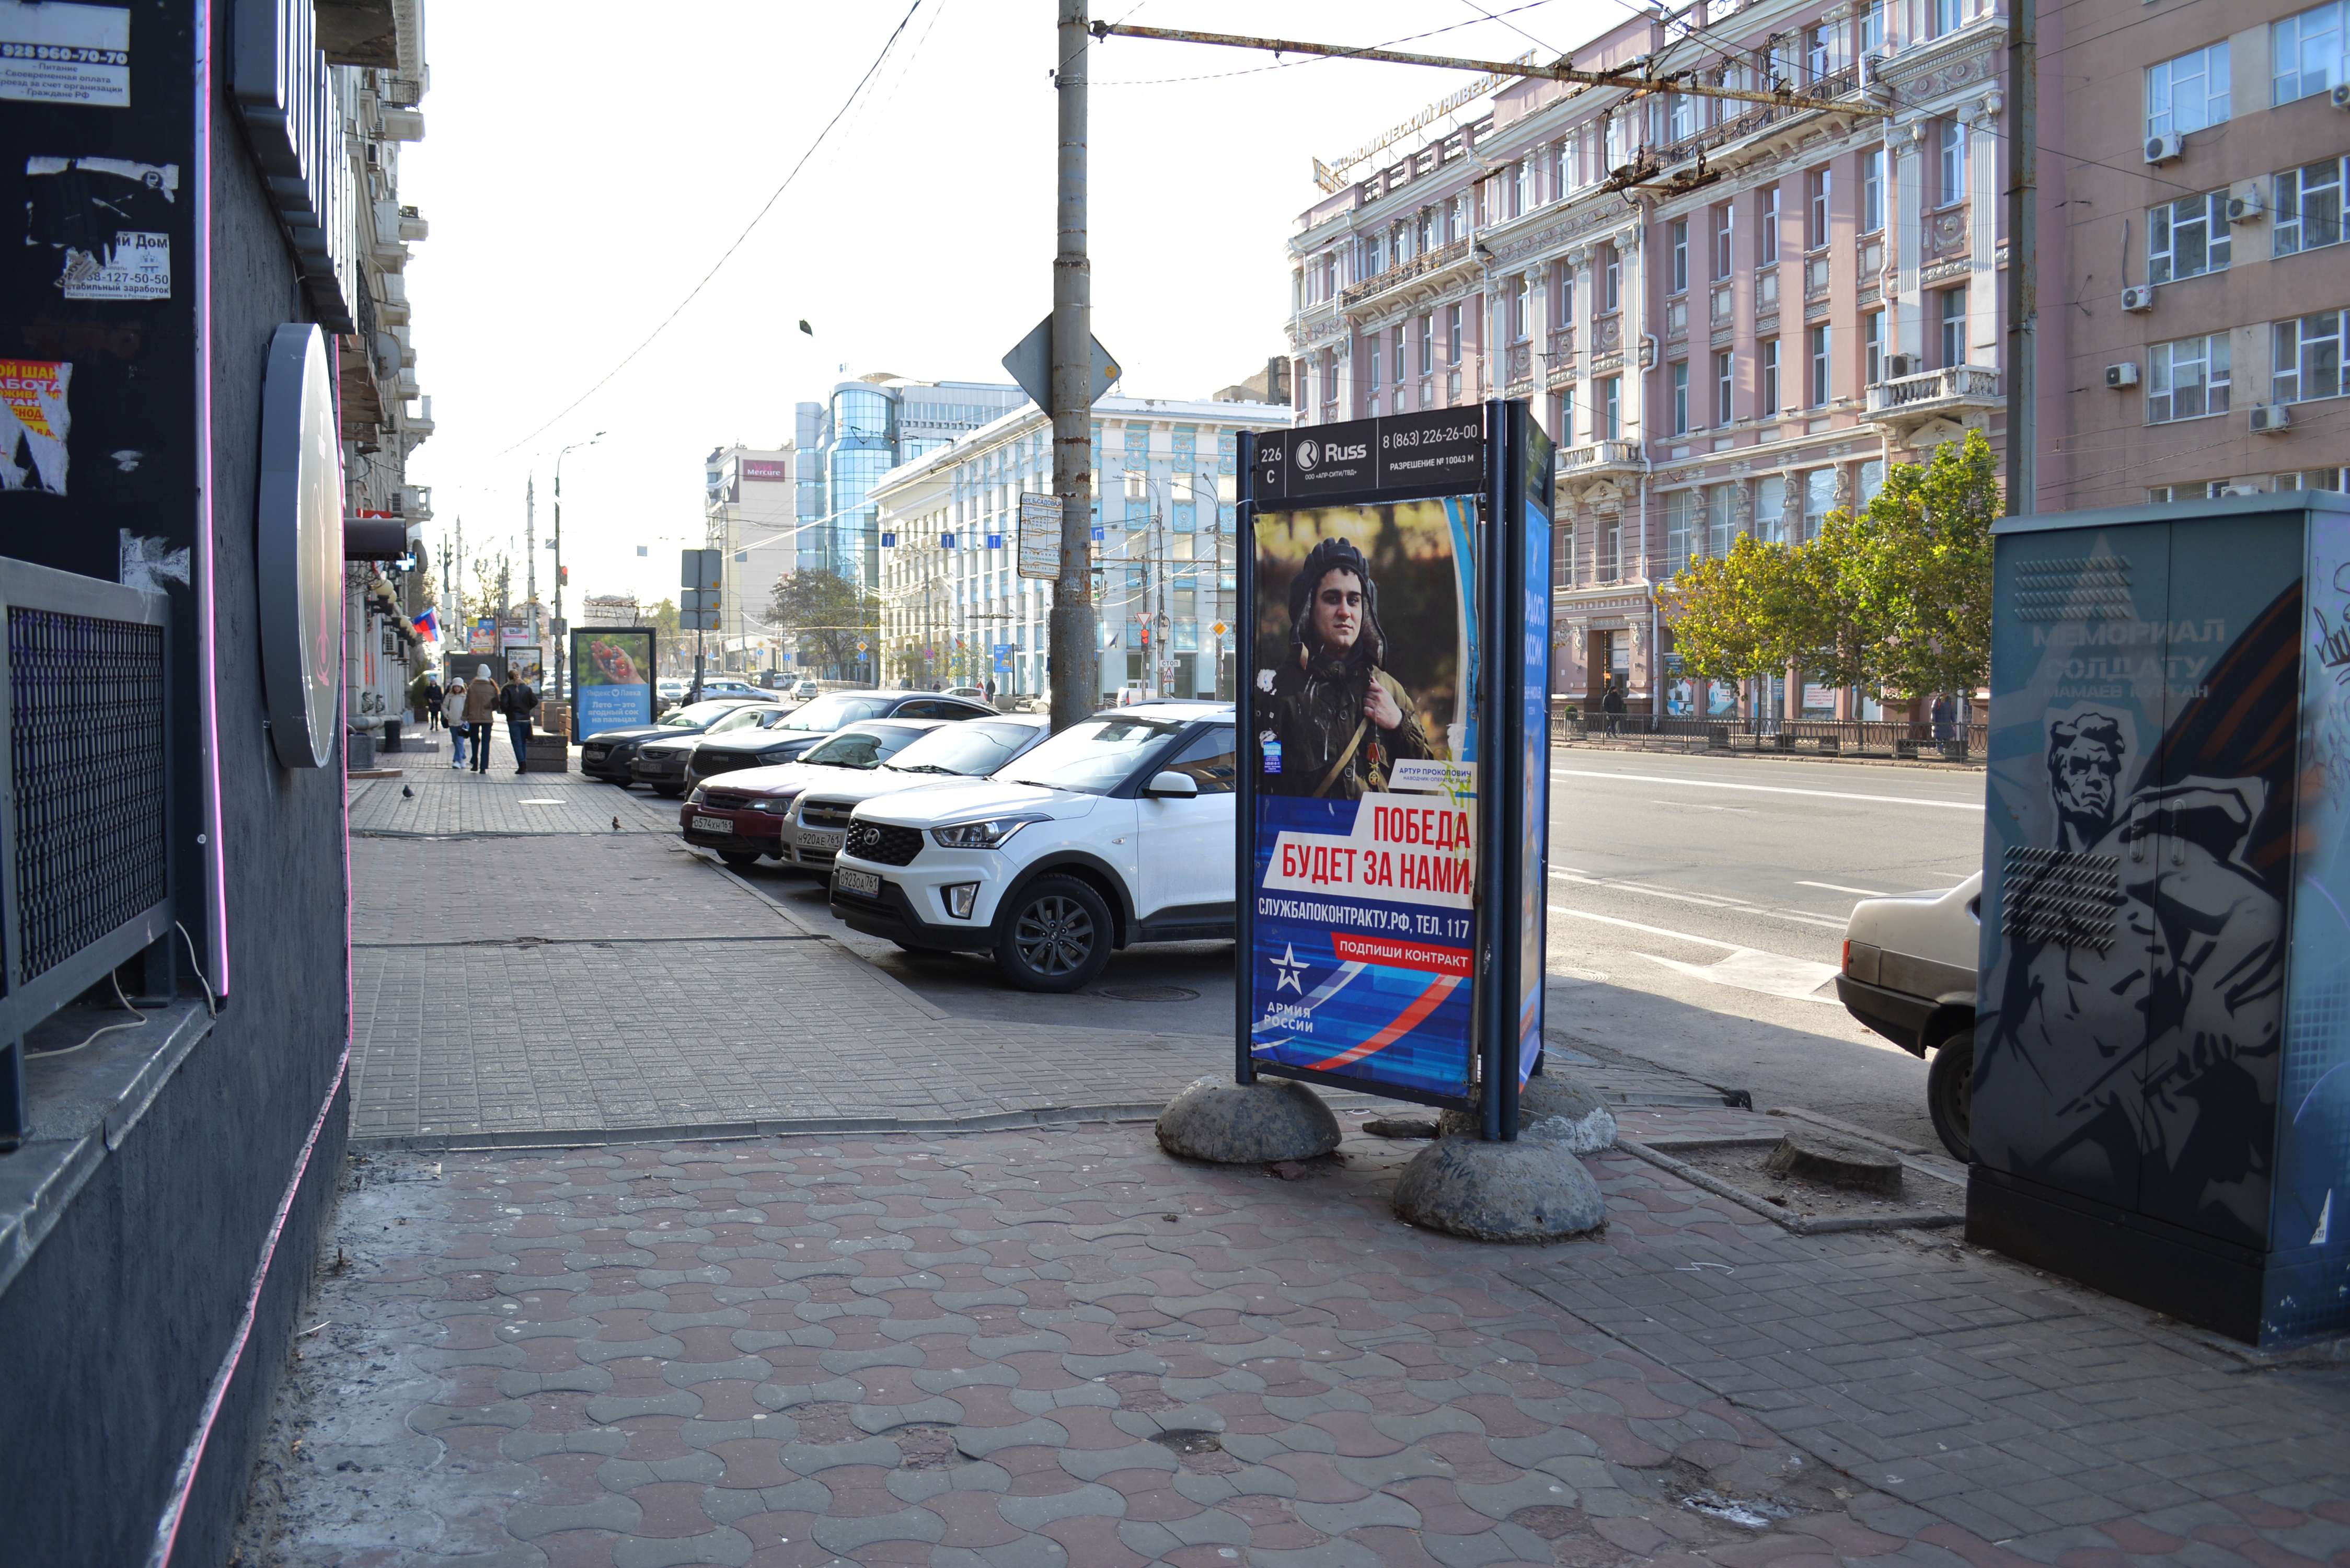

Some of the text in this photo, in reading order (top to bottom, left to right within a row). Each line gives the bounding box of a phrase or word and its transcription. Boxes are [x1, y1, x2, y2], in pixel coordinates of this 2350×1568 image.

[3, 43, 128, 65] 928 960-70-70
[39, 63, 78, 72] Питание
[5, 70, 111, 84] Своевременная оплата
[1436, 48, 1538, 118] УНИВЕРСИЕТ
[27, 88, 73, 98] Граждане
[64, 84, 123, 93] организации
[136, 234, 168, 250] Дом
[86, 272, 169, 284] 38-127-50-50
[123, 285, 169, 294] заработок
[22, 366, 59, 379] ШАН
[1383, 424, 1478, 449] 8 (863) 226-26-00
[1261, 447, 1282, 463] 226
[1325, 443, 1367, 463] Russ
[1390, 454, 1474, 471] РАЗРЕШЕНИЕ № 10043 М
[1316, 469, 1357, 479] «АПР-СИТИ/ТВД»
[2032, 619, 2226, 648] МЕМОРИАЛ
[2045, 656, 2209, 682] СОЛДАТУ
[2044, 684, 2209, 699] МАМАЕВ КУРГАН
[1422, 768, 1471, 777] ПРОКОПОВИЧ
[694, 818, 732, 830] О574ХН 161
[1374, 806, 1471, 852] ПОБЕДА
[798, 833, 839, 846] Н920АЕ 761
[1282, 843, 1470, 895] БУДЕТ ЗА НАМИ
[840, 871, 877, 890] О923ОА 761
[1258, 897, 1470, 939] СЛУЖБАПОКОНТРАКТУ.РФ, ТЕЛ. 117
[1339, 940, 1469, 969] ПОДПИШИ КОНТРАКТ
[1267, 1001, 1311, 1019] АРМИЯ
[1263, 1013, 1314, 1033] РОССИИ
